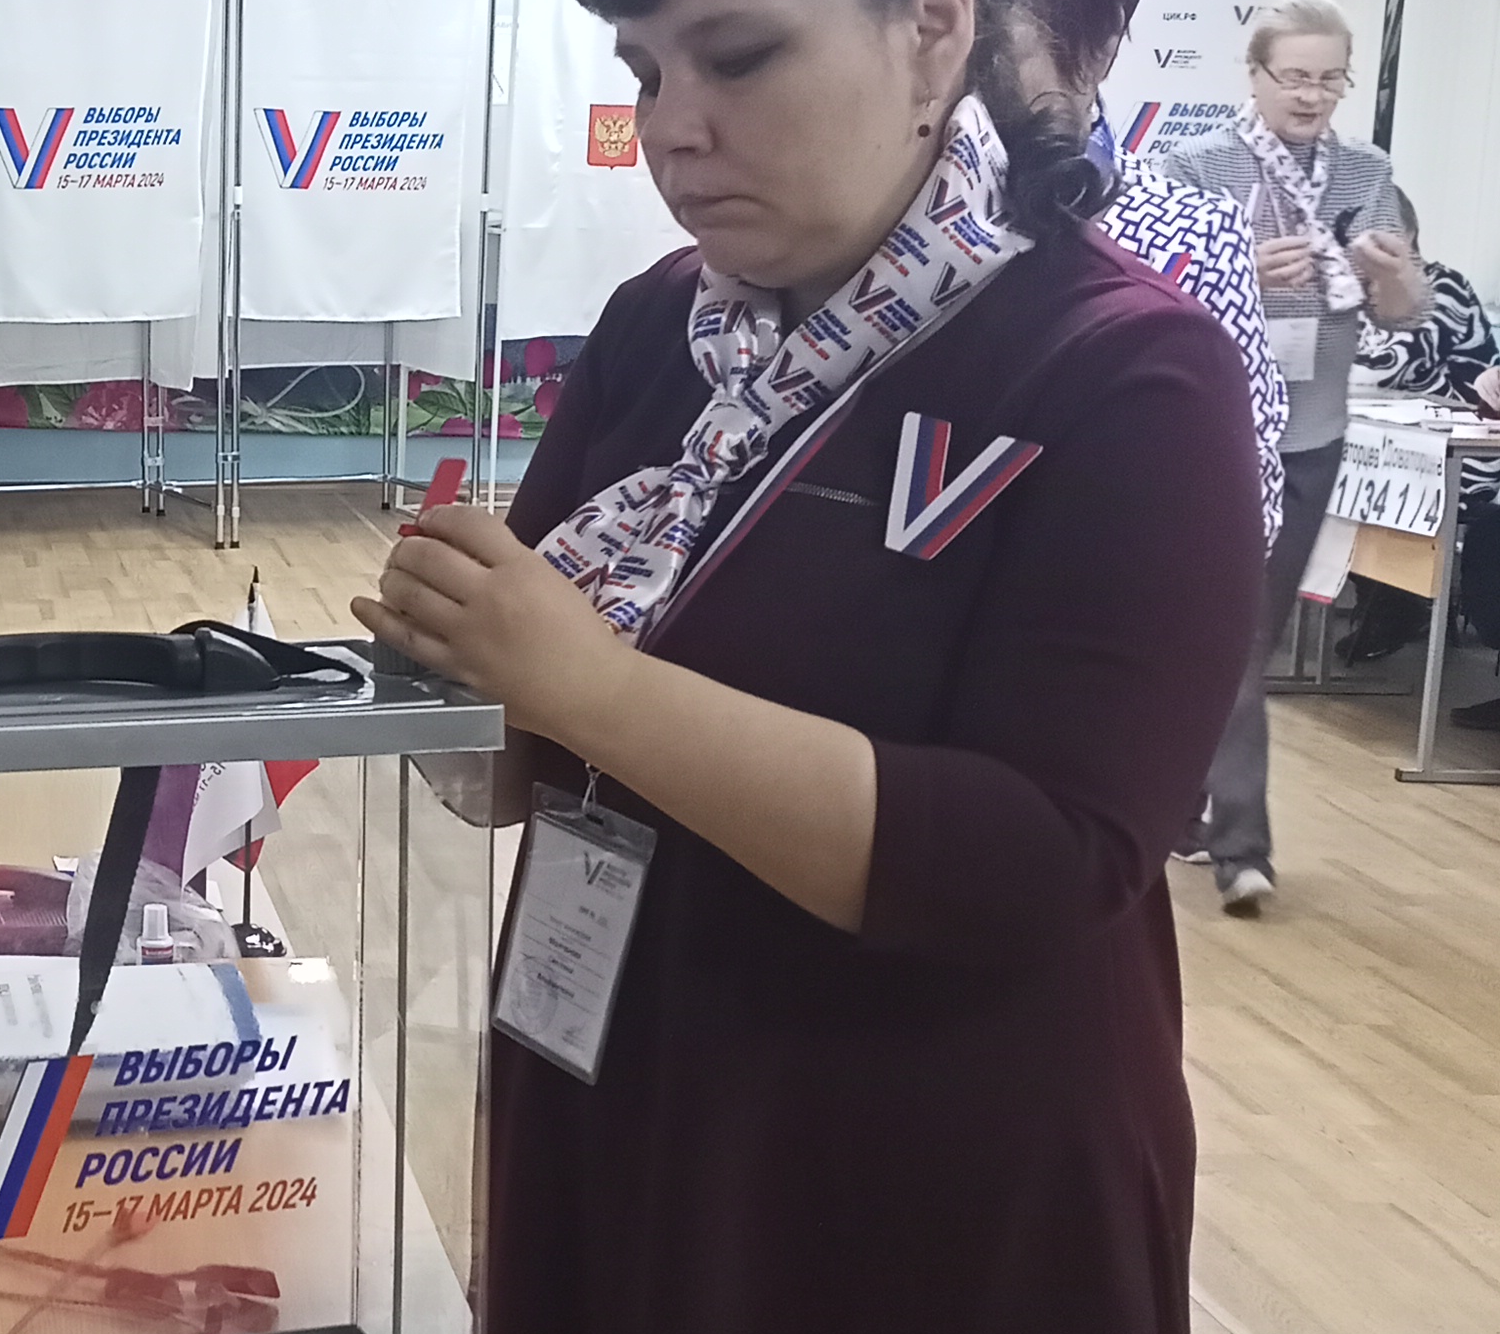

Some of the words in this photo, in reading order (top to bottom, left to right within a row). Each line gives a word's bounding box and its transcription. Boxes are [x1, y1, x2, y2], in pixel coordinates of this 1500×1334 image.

[83, 107, 161, 124] ВЫБОРЫ
[349, 111, 427, 128] ВЫБОРЫ
[73, 129, 181, 148] ПРЕЗИДЕНТА
[338, 133, 444, 152] ПРЕЗИДЕНТА
[63, 152, 137, 170] РОССИИ
[329, 155, 399, 172] РОССИИ
[92, 174, 136, 188] МАРТА
[137, 173, 164, 188] 2024
[356, 177, 398, 190] МАРТА
[399, 177, 427, 191] 2024
[113, 1035, 298, 1087] ВЫБОРЫ
[94, 1078, 351, 1137] ПРЕЗИДЕНТА
[75, 1138, 243, 1189] РОССИИ
[145, 1185, 244, 1223] МАРТА
[248, 1177, 318, 1213] 2024
